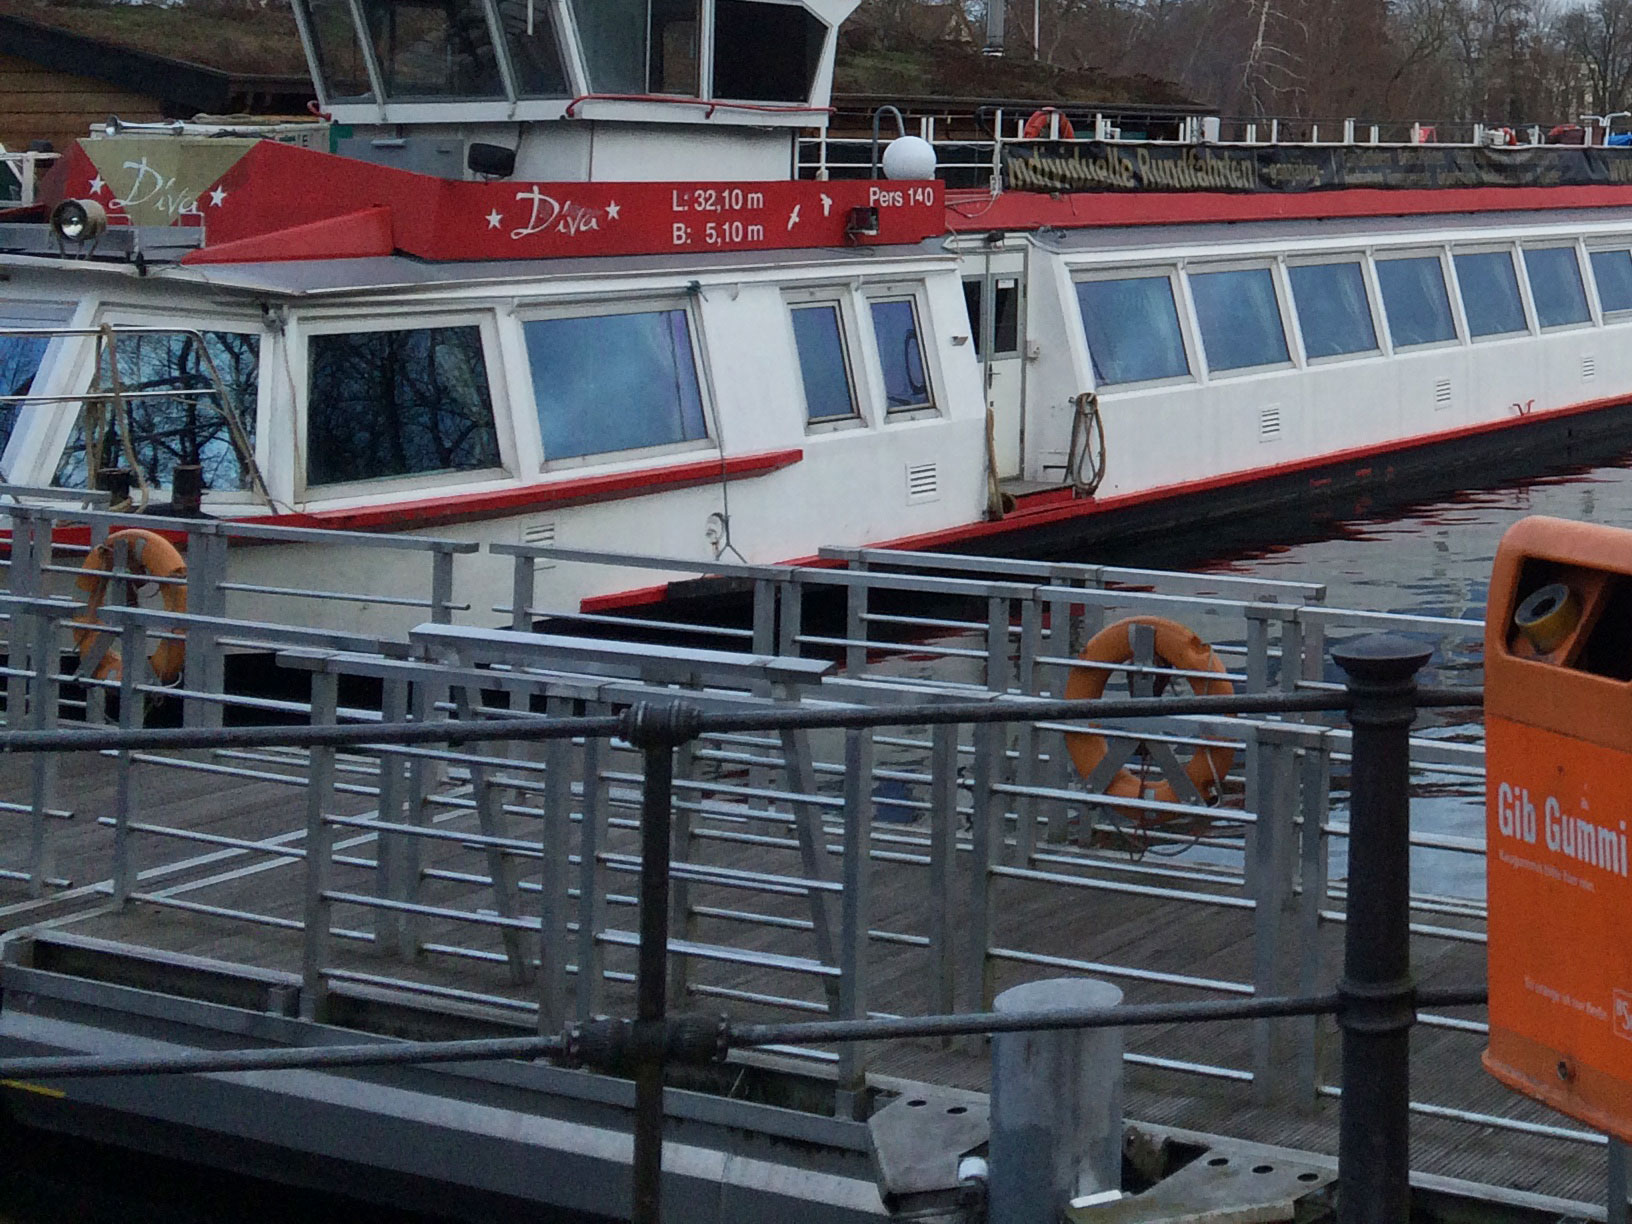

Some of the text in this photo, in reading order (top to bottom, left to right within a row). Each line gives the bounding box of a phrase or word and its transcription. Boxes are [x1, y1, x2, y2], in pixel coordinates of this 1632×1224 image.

[108, 156, 198, 216] Diva
[672, 188, 764, 213] L: 32,10 m
[869, 186, 934, 207] Pers 140
[510, 184, 600, 240] Diva
[672, 221, 764, 247] B: 5,10 m
[1498, 781, 1537, 844] Gib
[1544, 795, 1628, 878] Gummi
